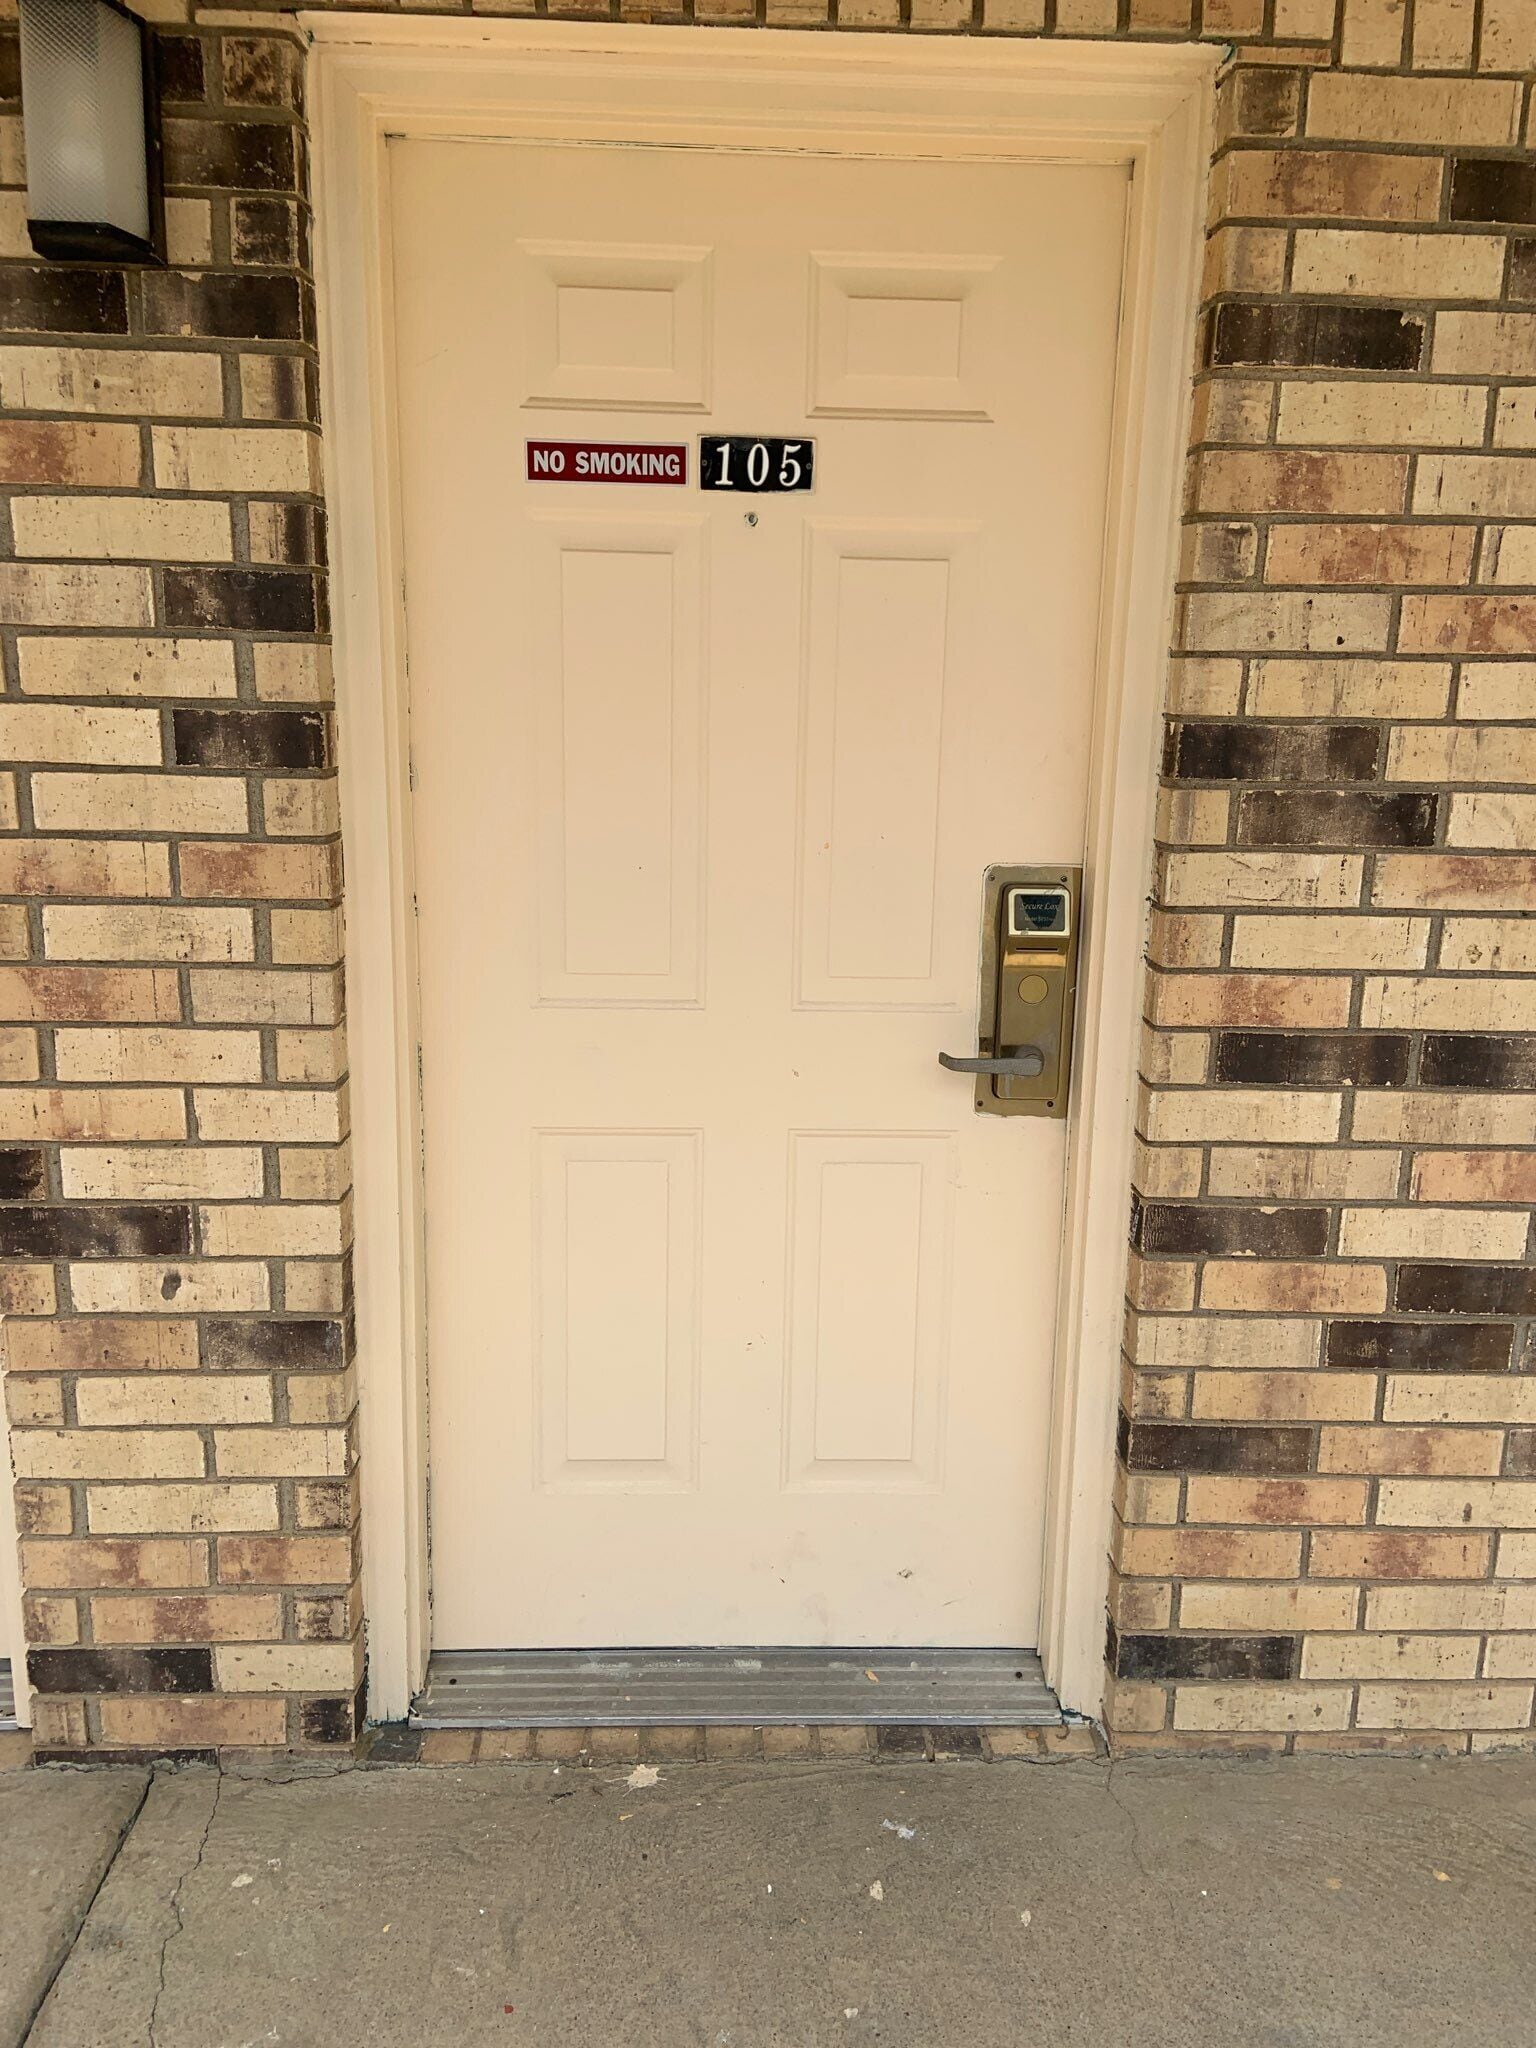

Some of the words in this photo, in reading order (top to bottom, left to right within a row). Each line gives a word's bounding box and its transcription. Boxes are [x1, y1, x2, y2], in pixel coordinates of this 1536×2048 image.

[533, 450, 565, 473] NO
[575, 451, 681, 477] SMOKING
[714, 442, 802, 487] 105
[1020, 902, 1043, 910] Secure
